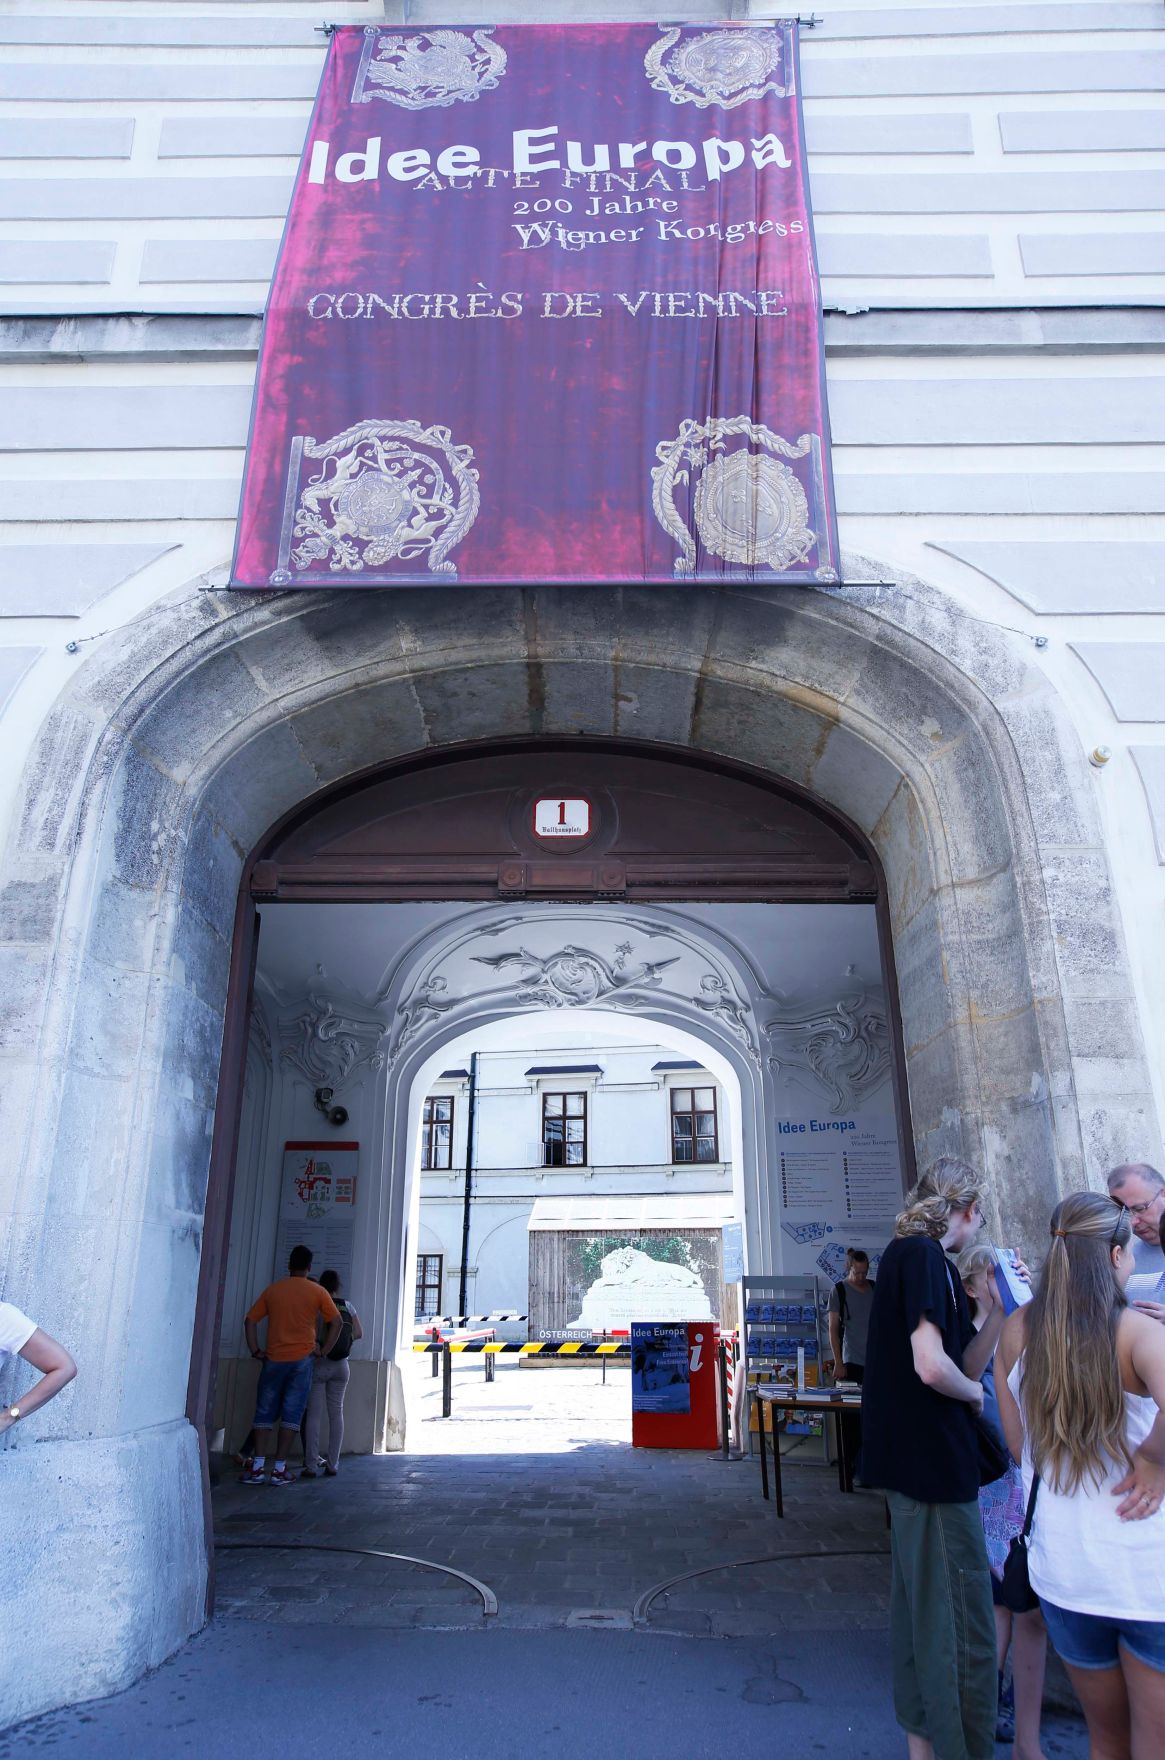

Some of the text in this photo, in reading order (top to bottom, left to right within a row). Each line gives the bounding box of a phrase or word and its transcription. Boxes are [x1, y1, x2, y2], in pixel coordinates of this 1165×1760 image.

[308, 126, 792, 184] Idee Europa
[413, 168, 706, 192] ACTE FINAL
[513, 195, 679, 216] 200 Jahre
[511, 218, 804, 244] Wiener Kongress
[307, 282, 788, 319] CONGRÈS DE VIENNE
[557, 801, 567, 825] 1
[778, 1119, 856, 1134] Idee Europa
[539, 1330, 593, 1339] ÖSTERREICH
[632, 1327, 685, 1338] Idee Europa
